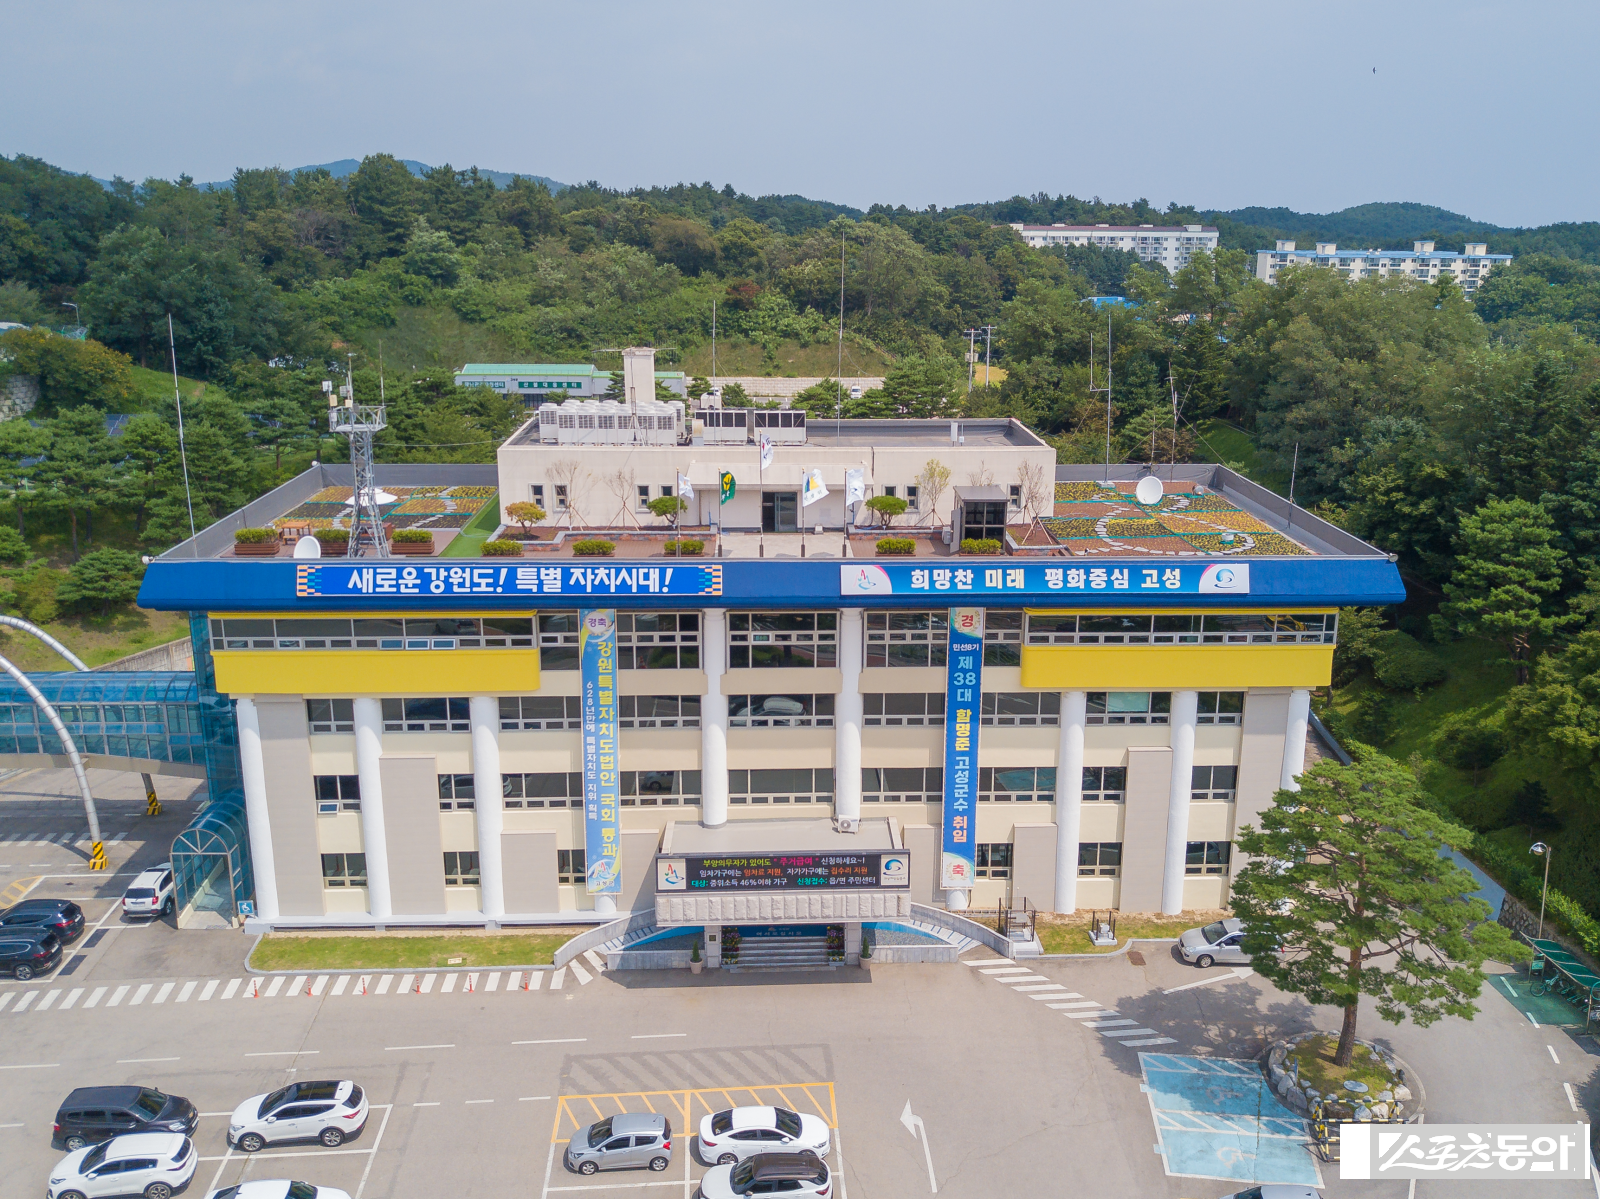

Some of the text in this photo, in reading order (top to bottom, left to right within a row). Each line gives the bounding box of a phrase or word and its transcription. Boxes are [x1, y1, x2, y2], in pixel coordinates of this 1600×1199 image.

[347, 566, 674, 593] 새로운 강원도! 특별 자치시대!
[910, 568, 1182, 590] 희망찬 미래 평화중심 고성
[588, 617, 607, 627] 경축
[952, 643, 980, 652] 민선8기
[585, 681, 597, 732] 628년만에
[597, 641, 618, 857] 강원특별자치도법안 국회 통과
[587, 783, 597, 800] 지위
[953, 756, 970, 812] 고성군수
[952, 815, 968, 843] 취임
[699, 869, 742, 877] 임차가구에는
[743, 868, 765, 876] 임차료
[786, 867, 829, 875] 자가가구에는
[831, 866, 852, 875] 집수리
[853, 866, 868, 874] 지원
[703, 858, 747, 867] 부양의무자가
[749, 858, 772, 867] 있어도
[691, 879, 709, 887] 대상:
[710, 879, 738, 887] 중위소득
[773, 878, 788, 886] 가구
[797, 877, 828, 885] 신청접수:
[829, 876, 846, 885] 읍/면
[847, 876, 876, 884] 주민센터
